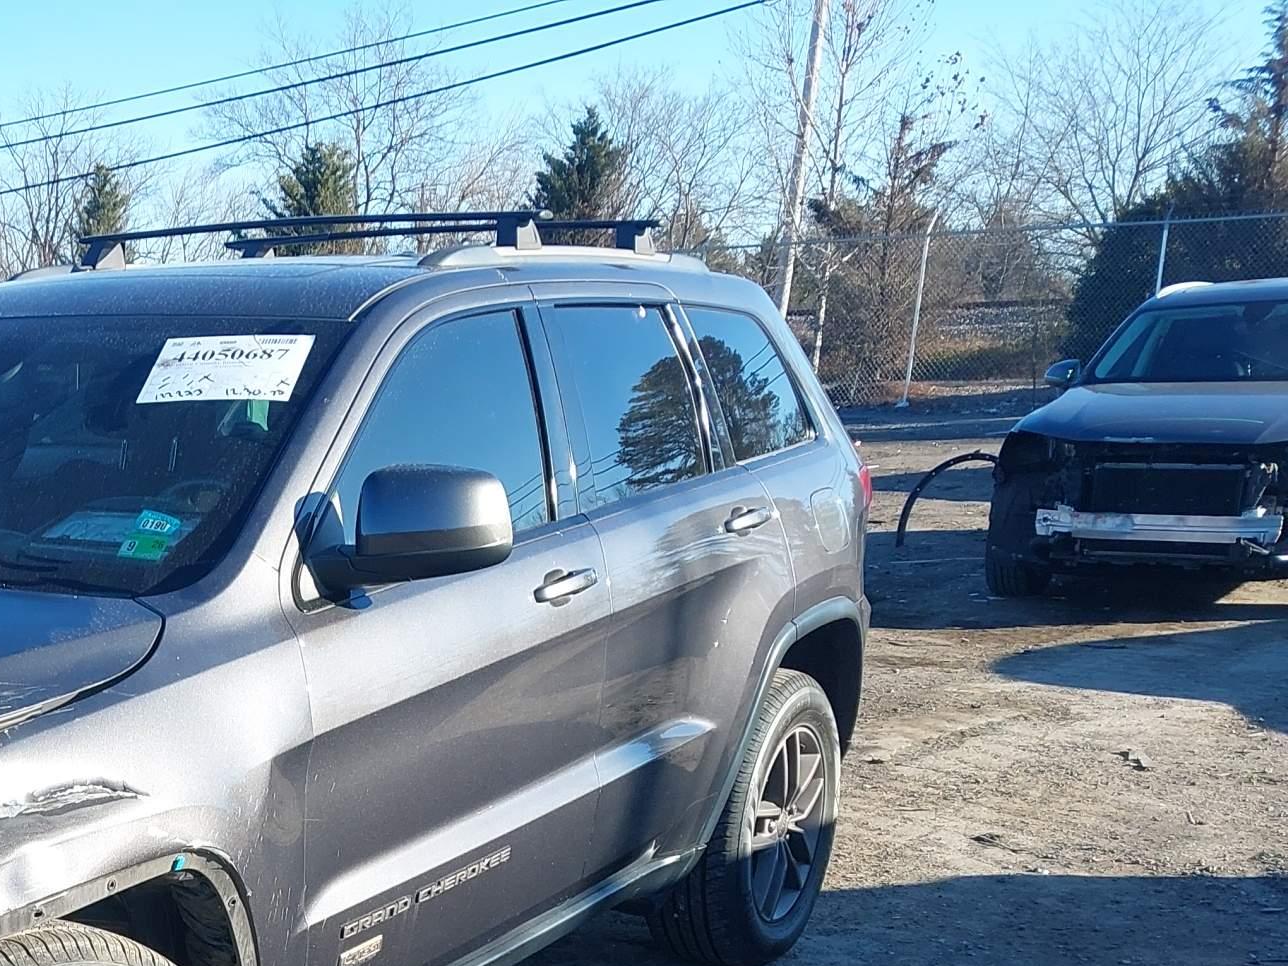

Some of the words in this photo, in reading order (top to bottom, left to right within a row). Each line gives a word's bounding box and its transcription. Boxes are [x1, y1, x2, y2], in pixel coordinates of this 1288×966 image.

[172, 347, 290, 362] 44050687
[340, 895, 411, 940] GRAND
[415, 845, 511, 903] CHEROKEE
